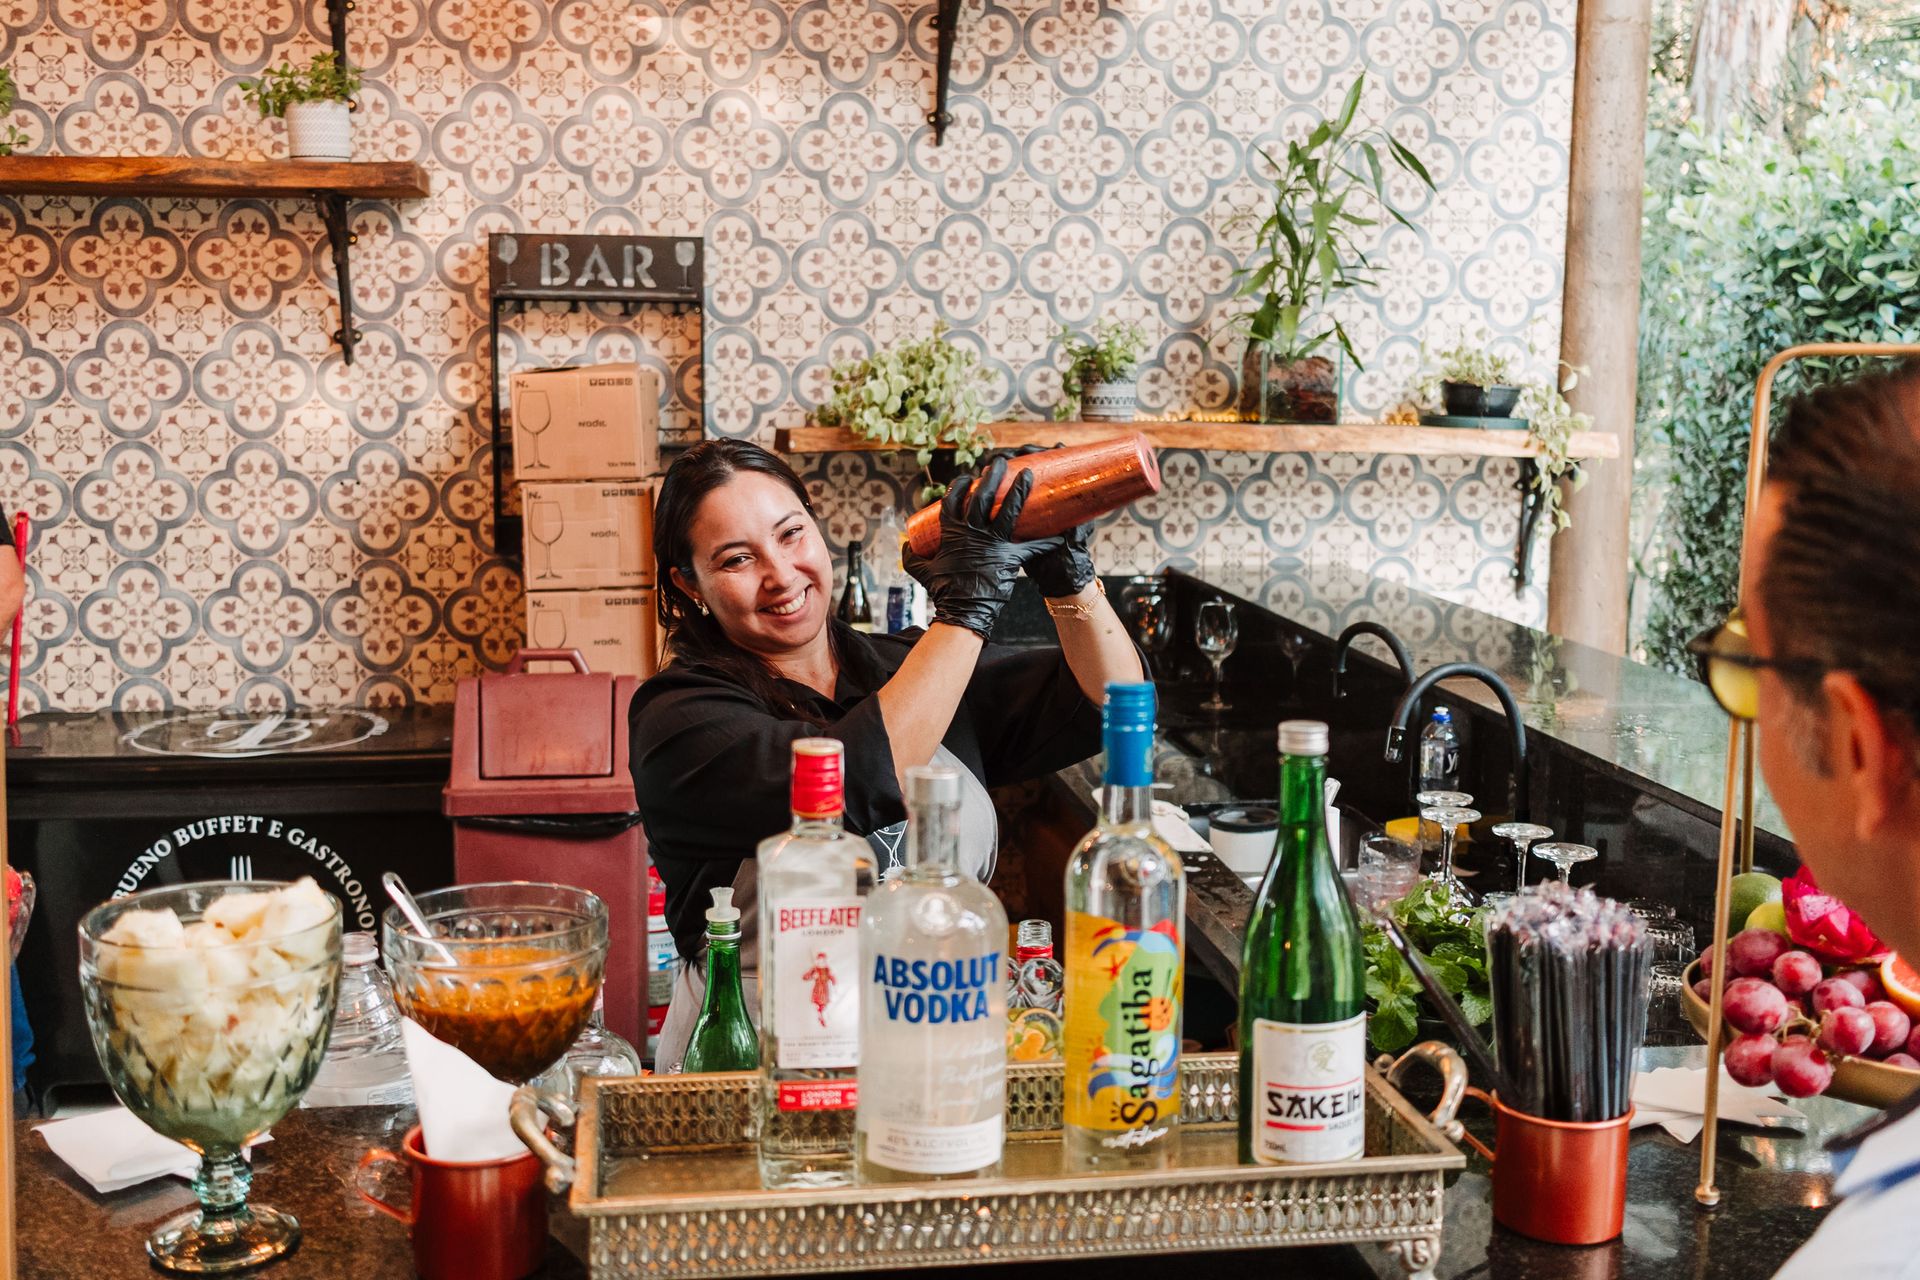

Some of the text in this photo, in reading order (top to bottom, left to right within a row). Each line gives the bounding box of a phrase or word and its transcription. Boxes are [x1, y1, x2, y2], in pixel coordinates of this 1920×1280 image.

[540, 243, 657, 288] BAR
[111, 815, 378, 939] BUENO BUFFET E GASTRONO
[874, 952, 1000, 991] ABSOLUT
[884, 990, 989, 1024] VODKA
[1120, 967, 1161, 1125] Sagatiba
